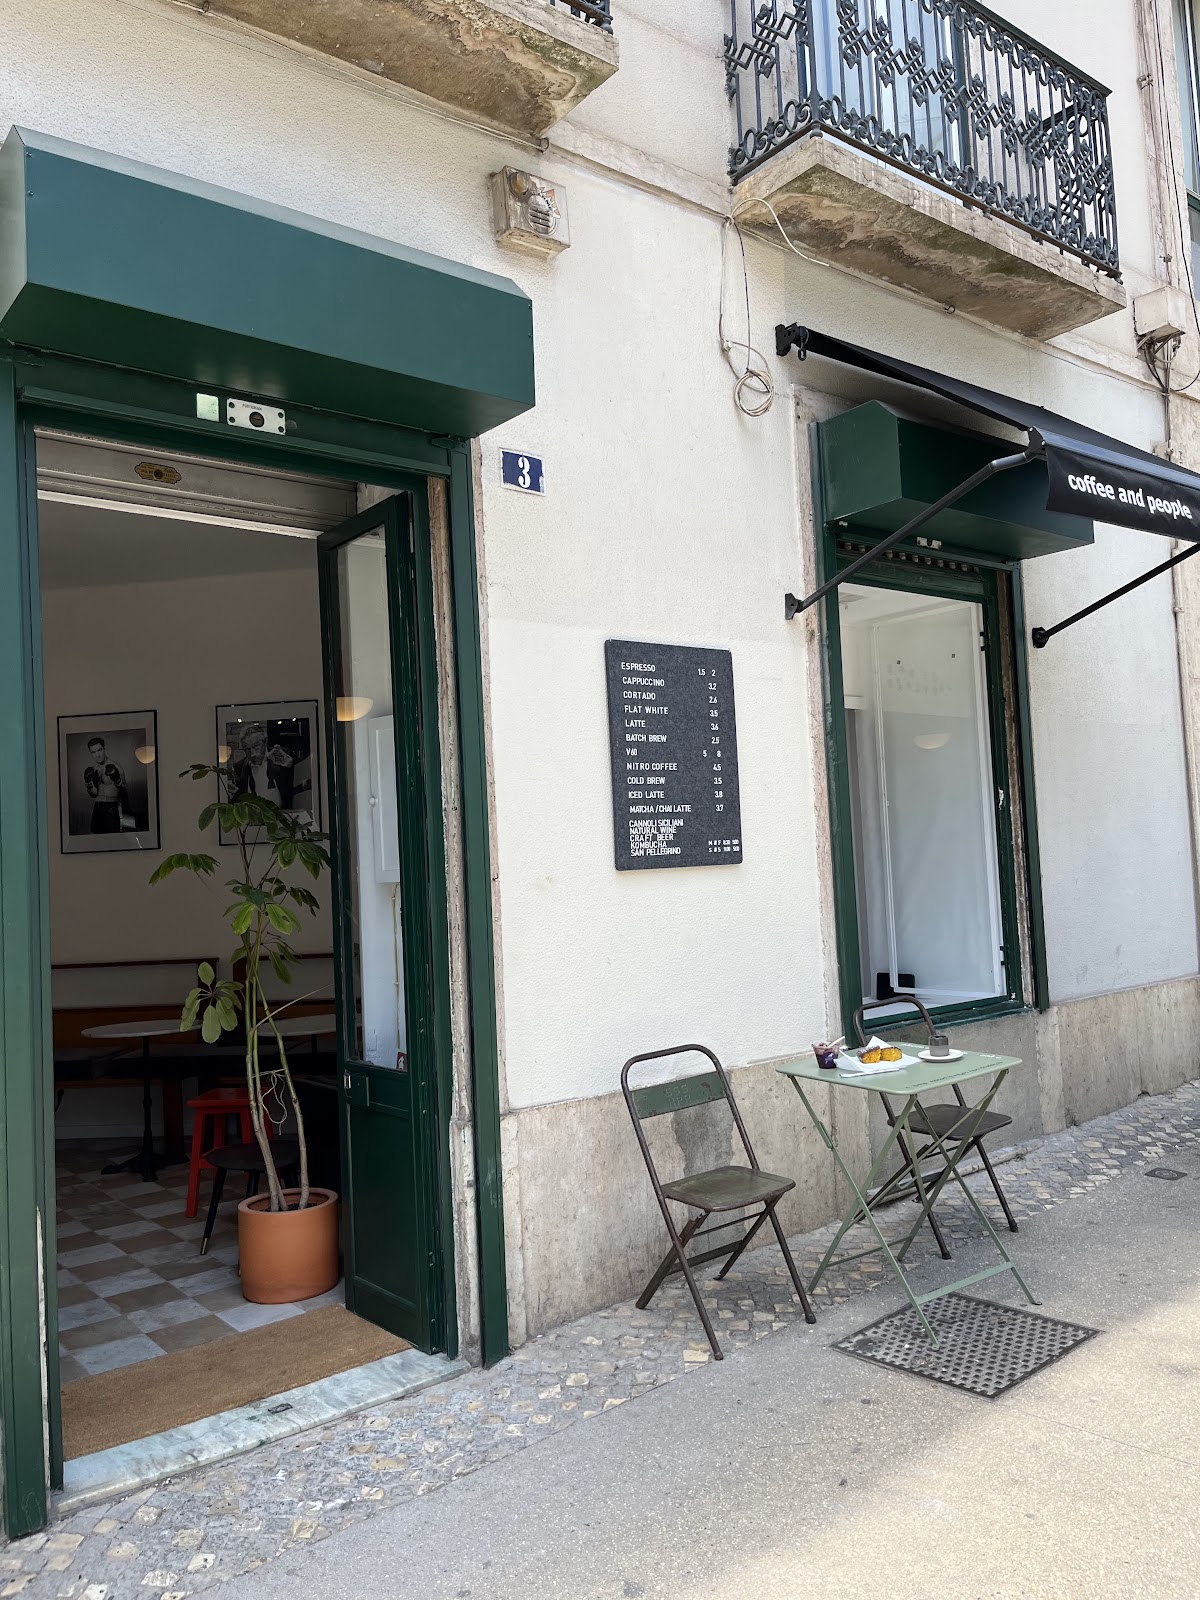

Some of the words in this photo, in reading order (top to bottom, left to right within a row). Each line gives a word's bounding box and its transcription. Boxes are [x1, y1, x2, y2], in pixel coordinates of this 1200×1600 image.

[518, 456, 531, 488] 3
[1068, 475, 1115, 500] coffee
[1118, 487, 1145, 508] and
[1147, 495, 1193, 519] people
[620, 662, 656, 672] ESPRESSO
[698, 668, 706, 676] 1.5
[711, 668, 716, 677] 2
[622, 676, 664, 686] CAPPUCCINO
[708, 682, 716, 690] 3.2
[622, 690, 656, 700] CORTADO
[708, 696, 718, 704] 2.6
[624, 704, 642, 714] FLAT
[644, 706, 668, 714] WHITE
[710, 710, 718, 718] 3.5
[624, 720, 646, 728] LATTE
[626, 734, 646, 742] BATCH
[648, 734, 668, 742] BREW
[712, 736, 720, 744] 2.5
[626, 748, 638, 756] V60
[702, 749, 708, 758] 5
[626, 762, 650, 770] NITRO
[652, 762, 678, 770] COFFEE
[626, 776, 644, 784] COLD
[646, 776, 666, 784] BREW
[714, 776, 722, 784] 3.5
[628, 790, 644, 798] ICED
[644, 790, 664, 798] LATTE
[630, 804, 654, 814] MATCHA
[674, 804, 692, 812] LATTE
[629, 826, 659, 835] NATURAL
[660, 826, 677, 834] WINE
[629, 834, 653, 842] CRAFT
[656, 833, 674, 841] BEER
[630, 840, 667, 849] KOMBUCHA
[630, 848, 645, 857] SAN
